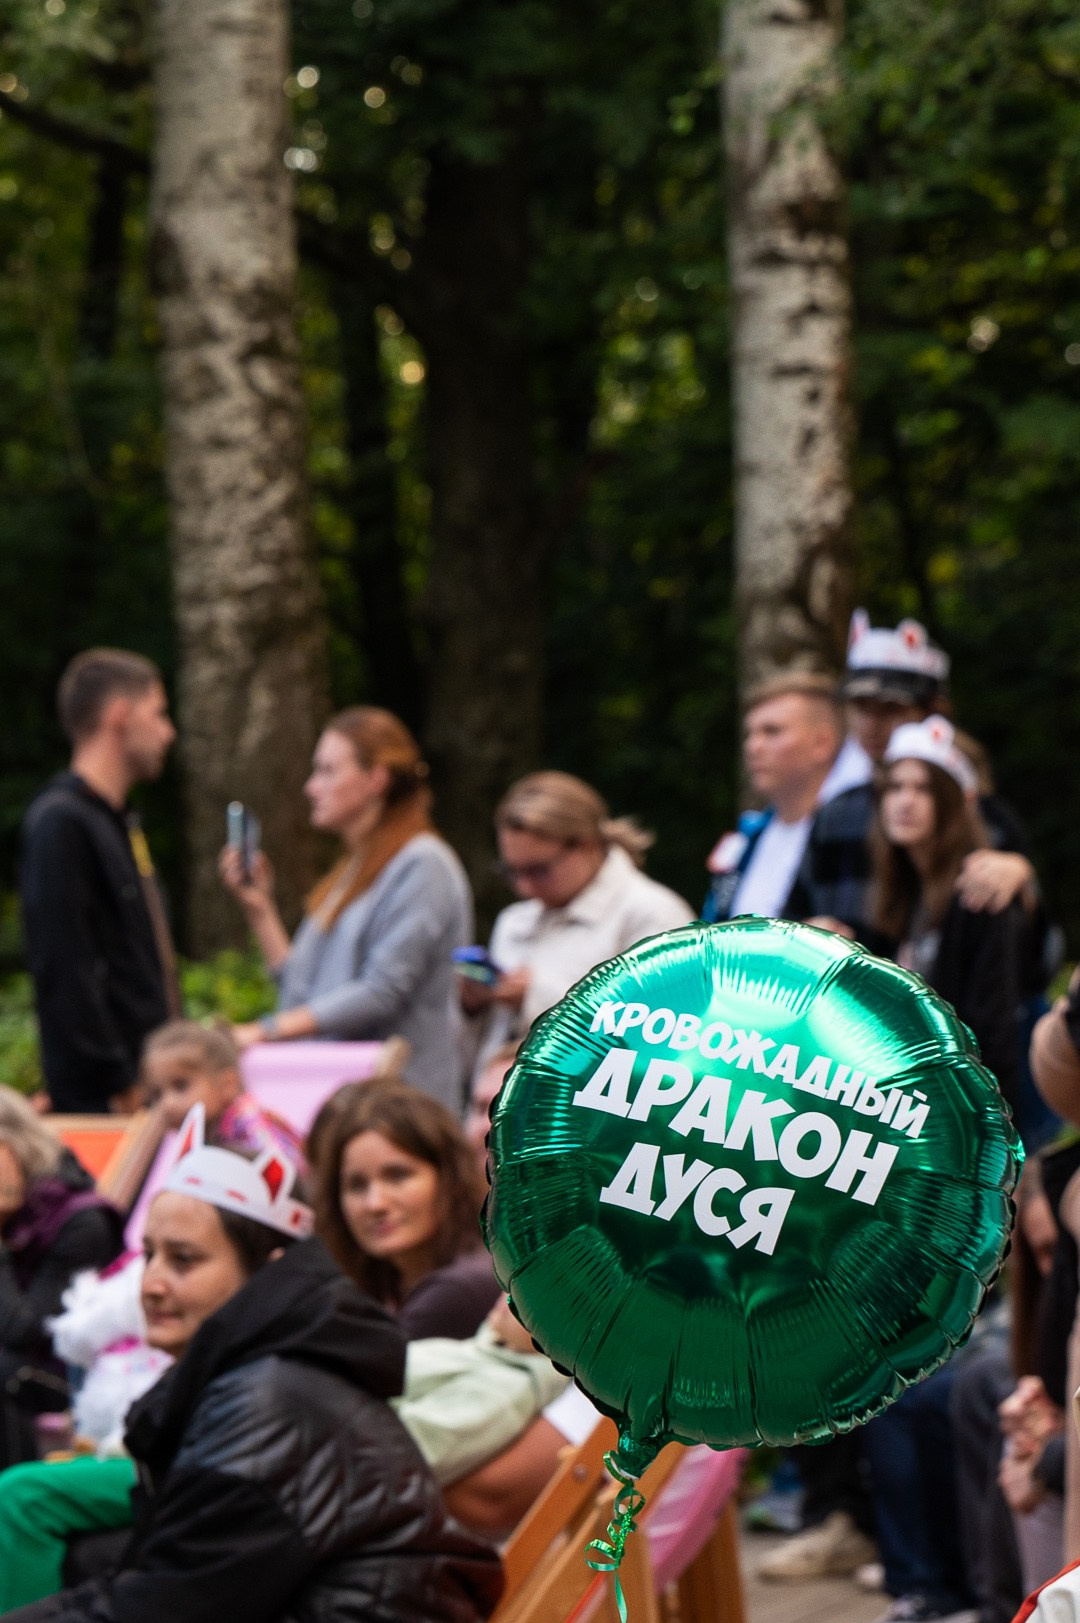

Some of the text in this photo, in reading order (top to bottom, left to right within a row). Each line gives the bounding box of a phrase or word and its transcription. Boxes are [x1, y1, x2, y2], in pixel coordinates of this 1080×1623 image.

[572, 1046, 900, 1206] ДРАКОН
[589, 1000, 931, 1139] КРОВОЖАДНЫЙ
[598, 1141, 796, 1256] ДУСЯ
